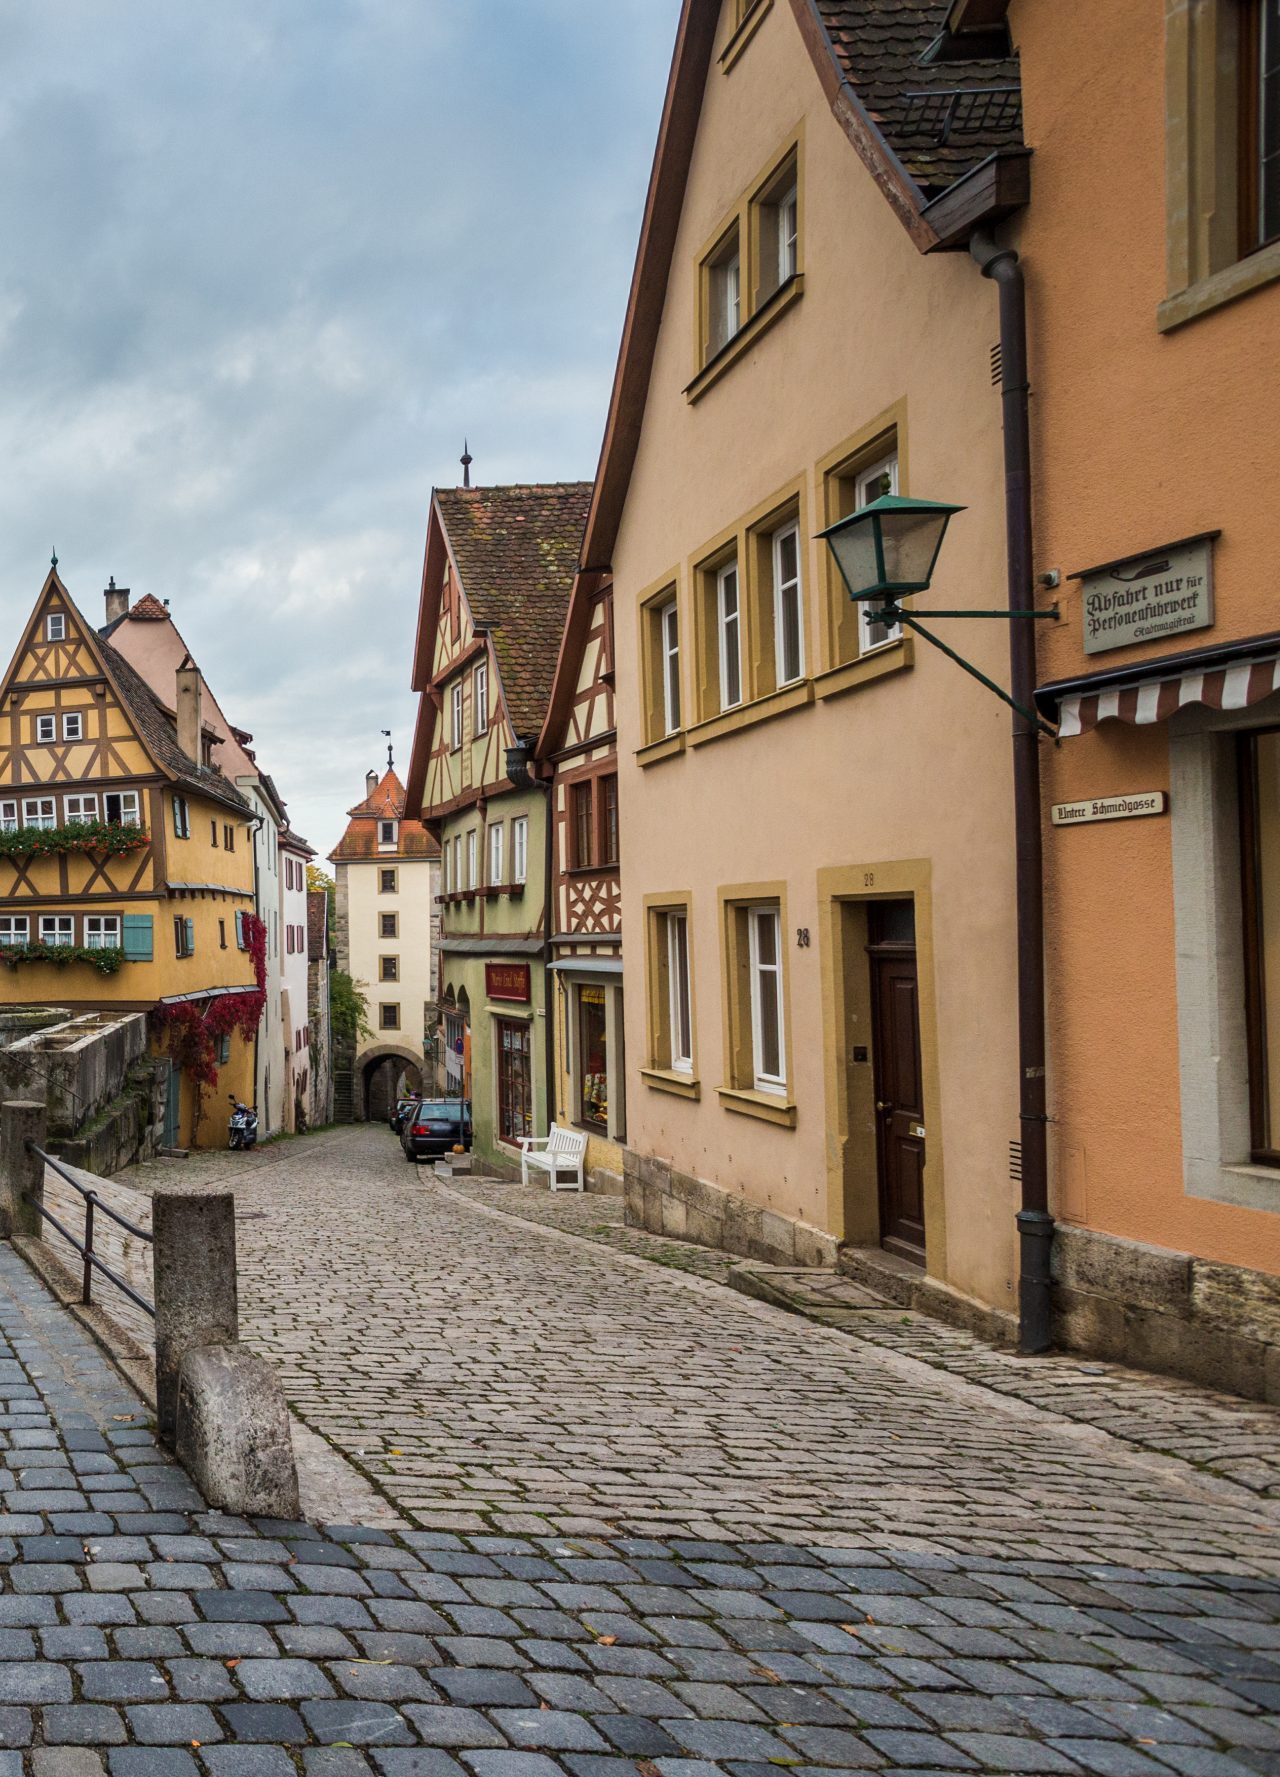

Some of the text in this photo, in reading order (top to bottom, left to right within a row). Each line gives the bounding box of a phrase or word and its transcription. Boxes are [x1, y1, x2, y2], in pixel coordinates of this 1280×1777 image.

[1087, 576, 1203, 617] Abfahrt nur für
[1088, 591, 1199, 636] Personenfuhrwerk
[1133, 613, 1196, 637] Stadtmagistrat
[1058, 799, 1155, 820] Untere Schmiedgasse
[864, 873, 874, 886] 28
[796, 928, 810, 948] 28
